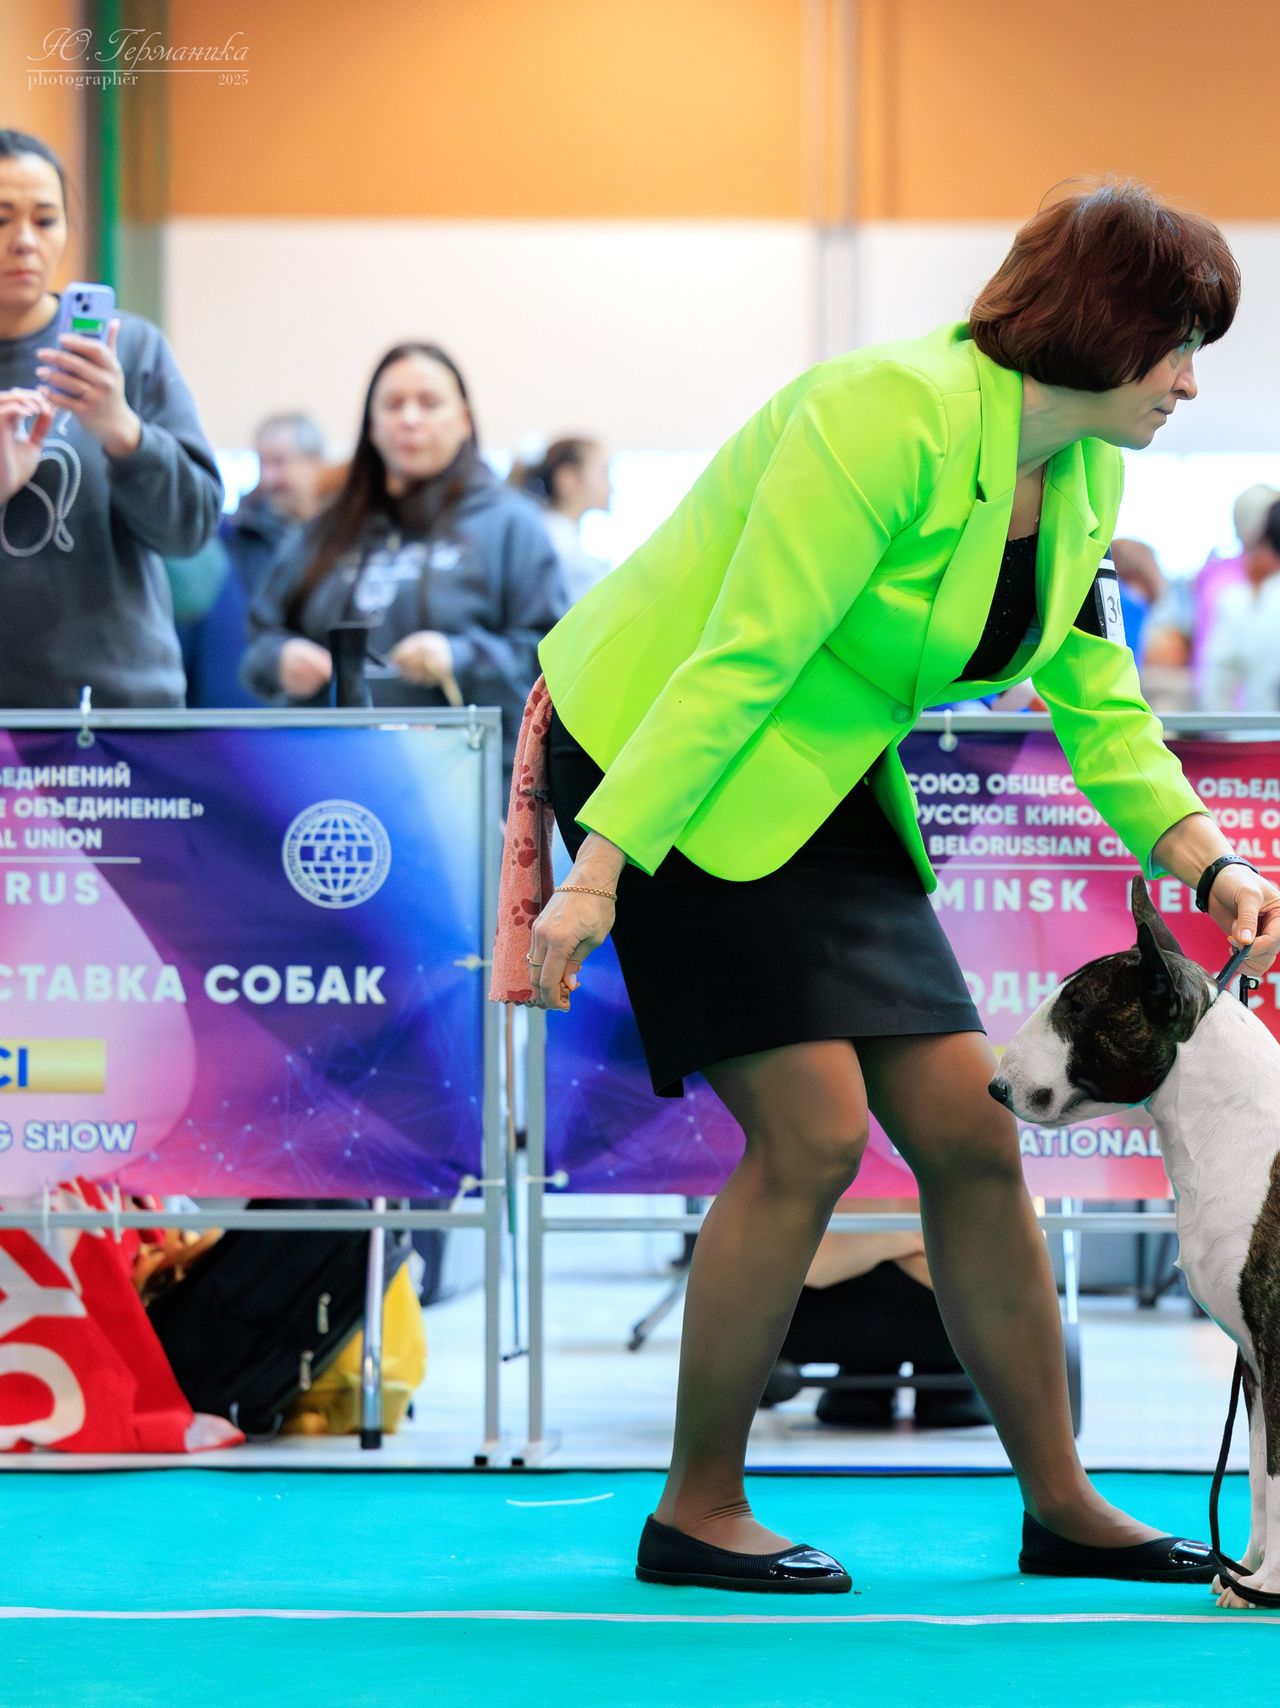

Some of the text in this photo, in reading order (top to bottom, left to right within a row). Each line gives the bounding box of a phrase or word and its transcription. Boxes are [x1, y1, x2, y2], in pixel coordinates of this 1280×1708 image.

[0, 761, 131, 791] ЕДИНЕНИЙ
[986, 773, 1084, 798] ОБЩЕС
[13, 797, 205, 822] ОБЪЕДИНЕНИЕ»
[916, 803, 1018, 826] УССКОЕ
[25, 828, 103, 849] UNION
[929, 834, 1092, 858] BELORUSSIAN
[931, 877, 1089, 913] MINSK
[203, 963, 387, 1005] СОБАК
[23, 1120, 138, 1153] SHOW
